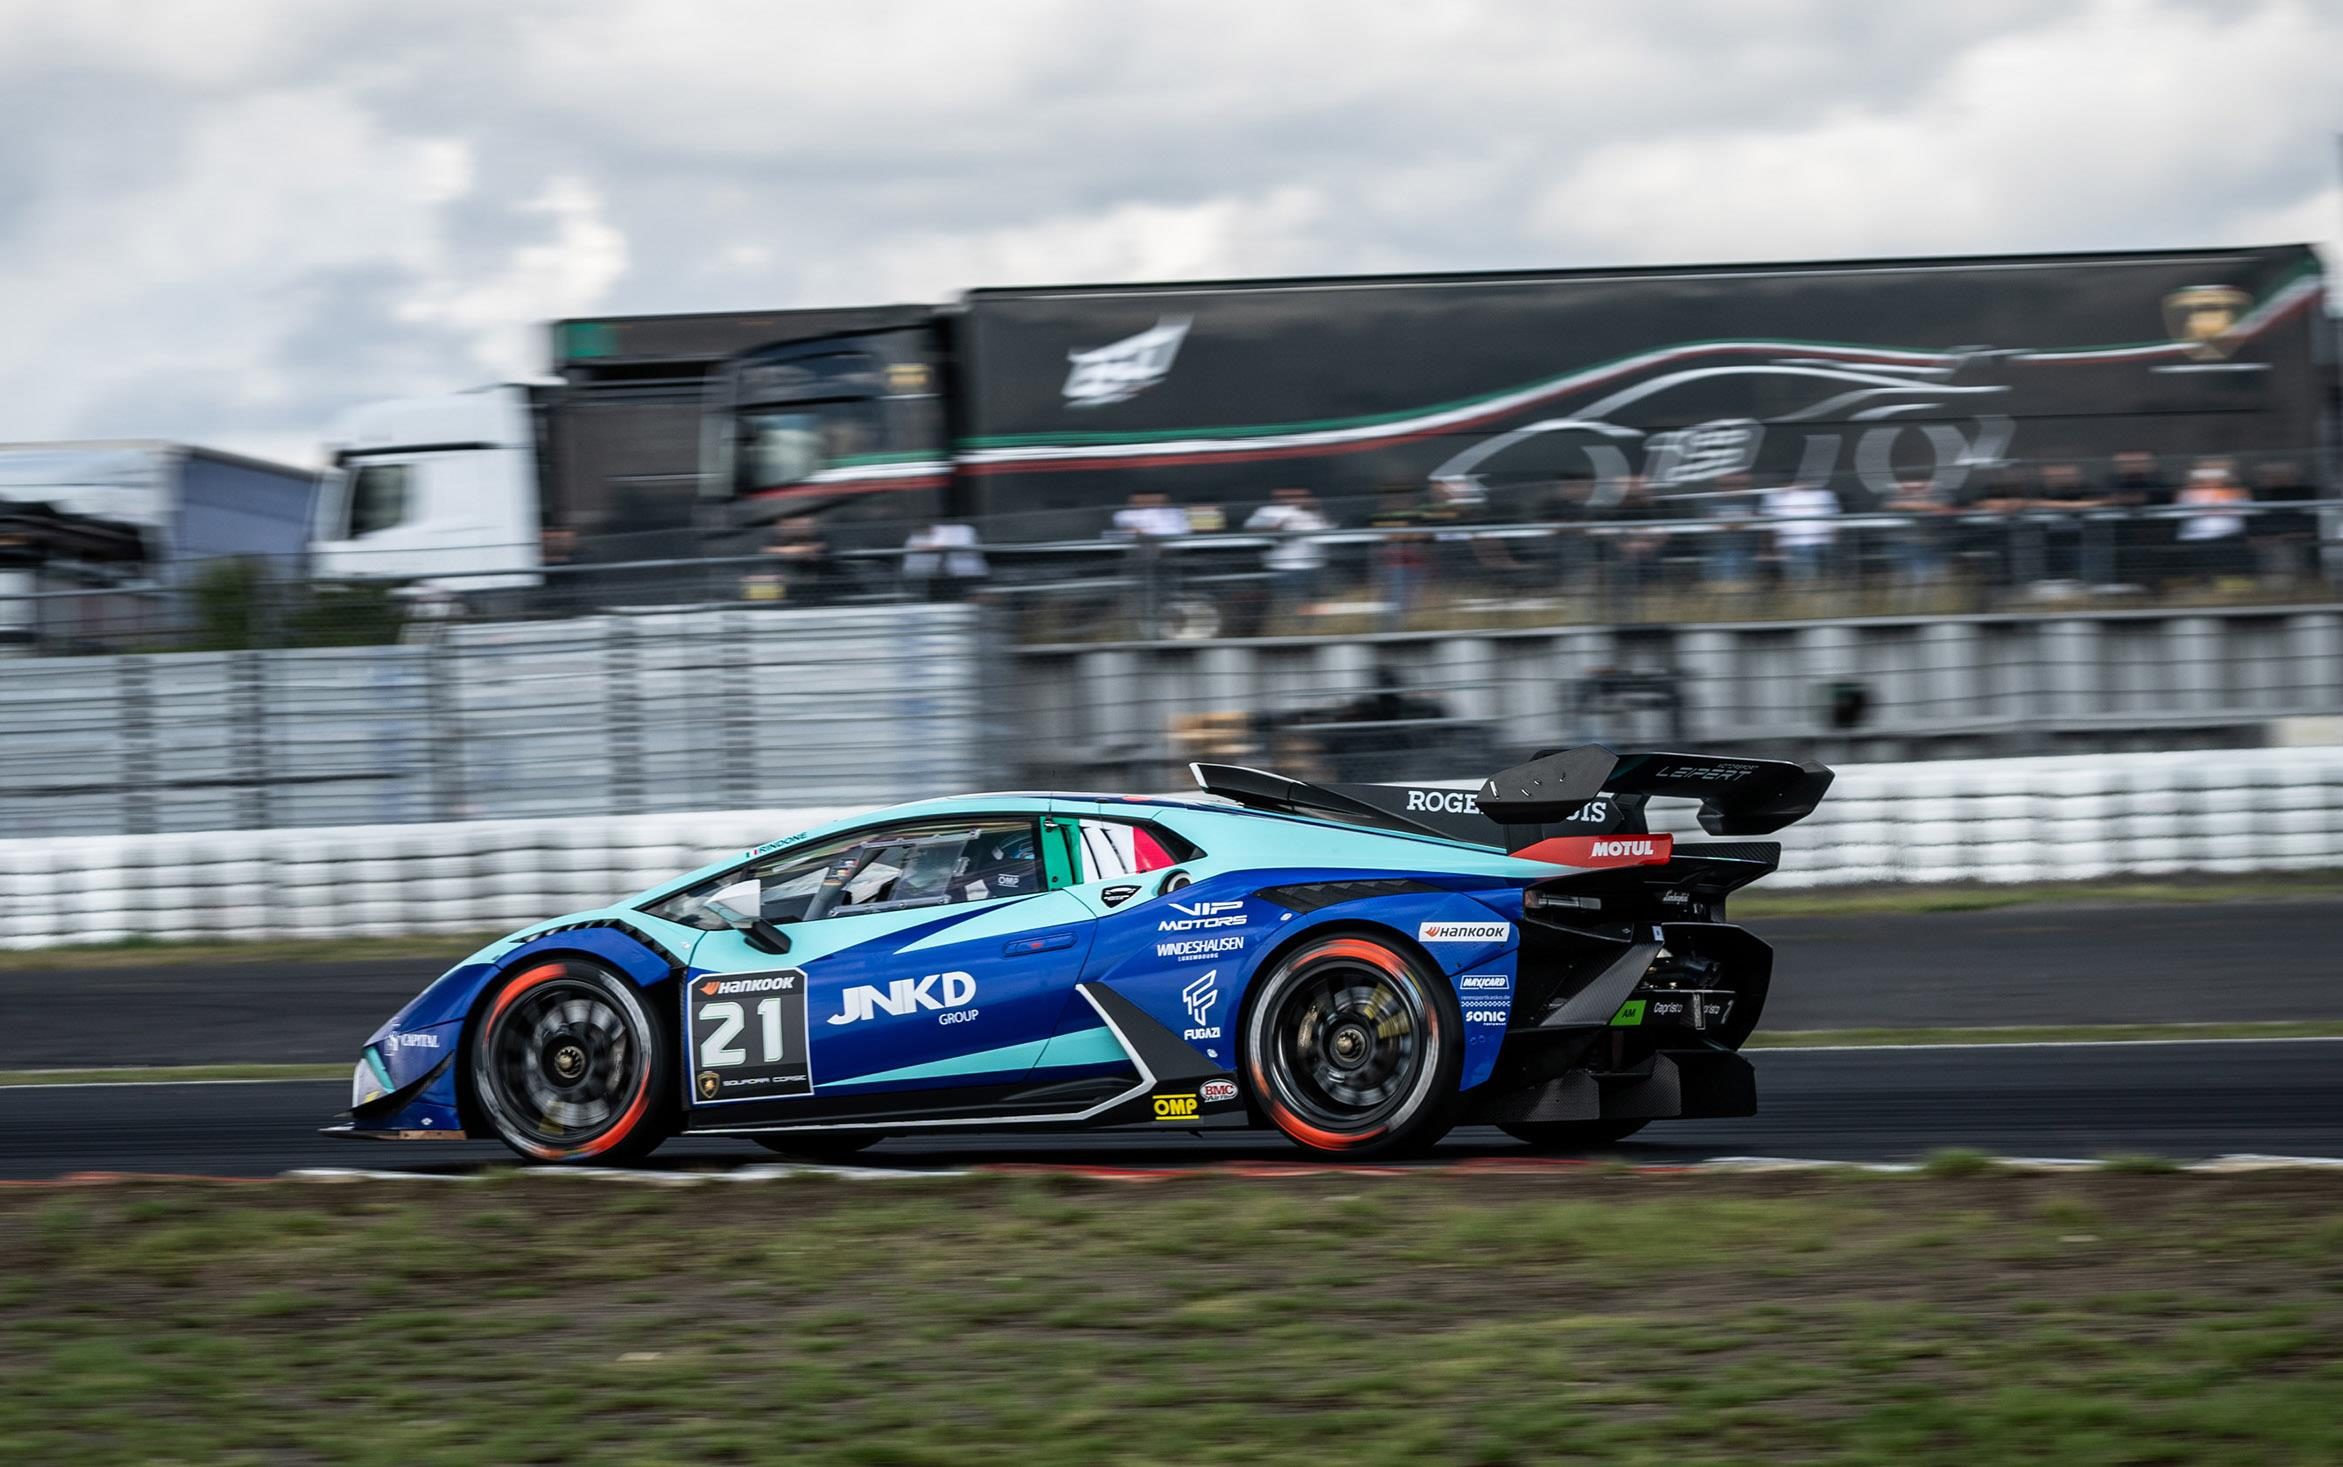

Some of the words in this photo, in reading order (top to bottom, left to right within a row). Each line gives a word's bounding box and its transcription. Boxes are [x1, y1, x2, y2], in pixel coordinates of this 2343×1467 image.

[1406, 790, 1484, 815] ROGE
[1591, 840, 1654, 857] MOTUL
[998, 875, 1019, 886] OMP
[1167, 901, 1243, 916] VIP
[1157, 914, 1248, 931] MOTORS
[1156, 936, 1244, 957] WINDESHAUSEN
[826, 971, 977, 1025] JNKD
[938, 1009, 980, 1026] GROUP
[1621, 1008, 1637, 1018] AM
[1653, 1002, 1684, 1016] Capristo
[698, 997, 784, 1068] 21
[1183, 1026, 1221, 1040] FUGAZI
[1205, 1084, 1235, 1096] BMC
[1153, 1096, 1198, 1116] OMP
